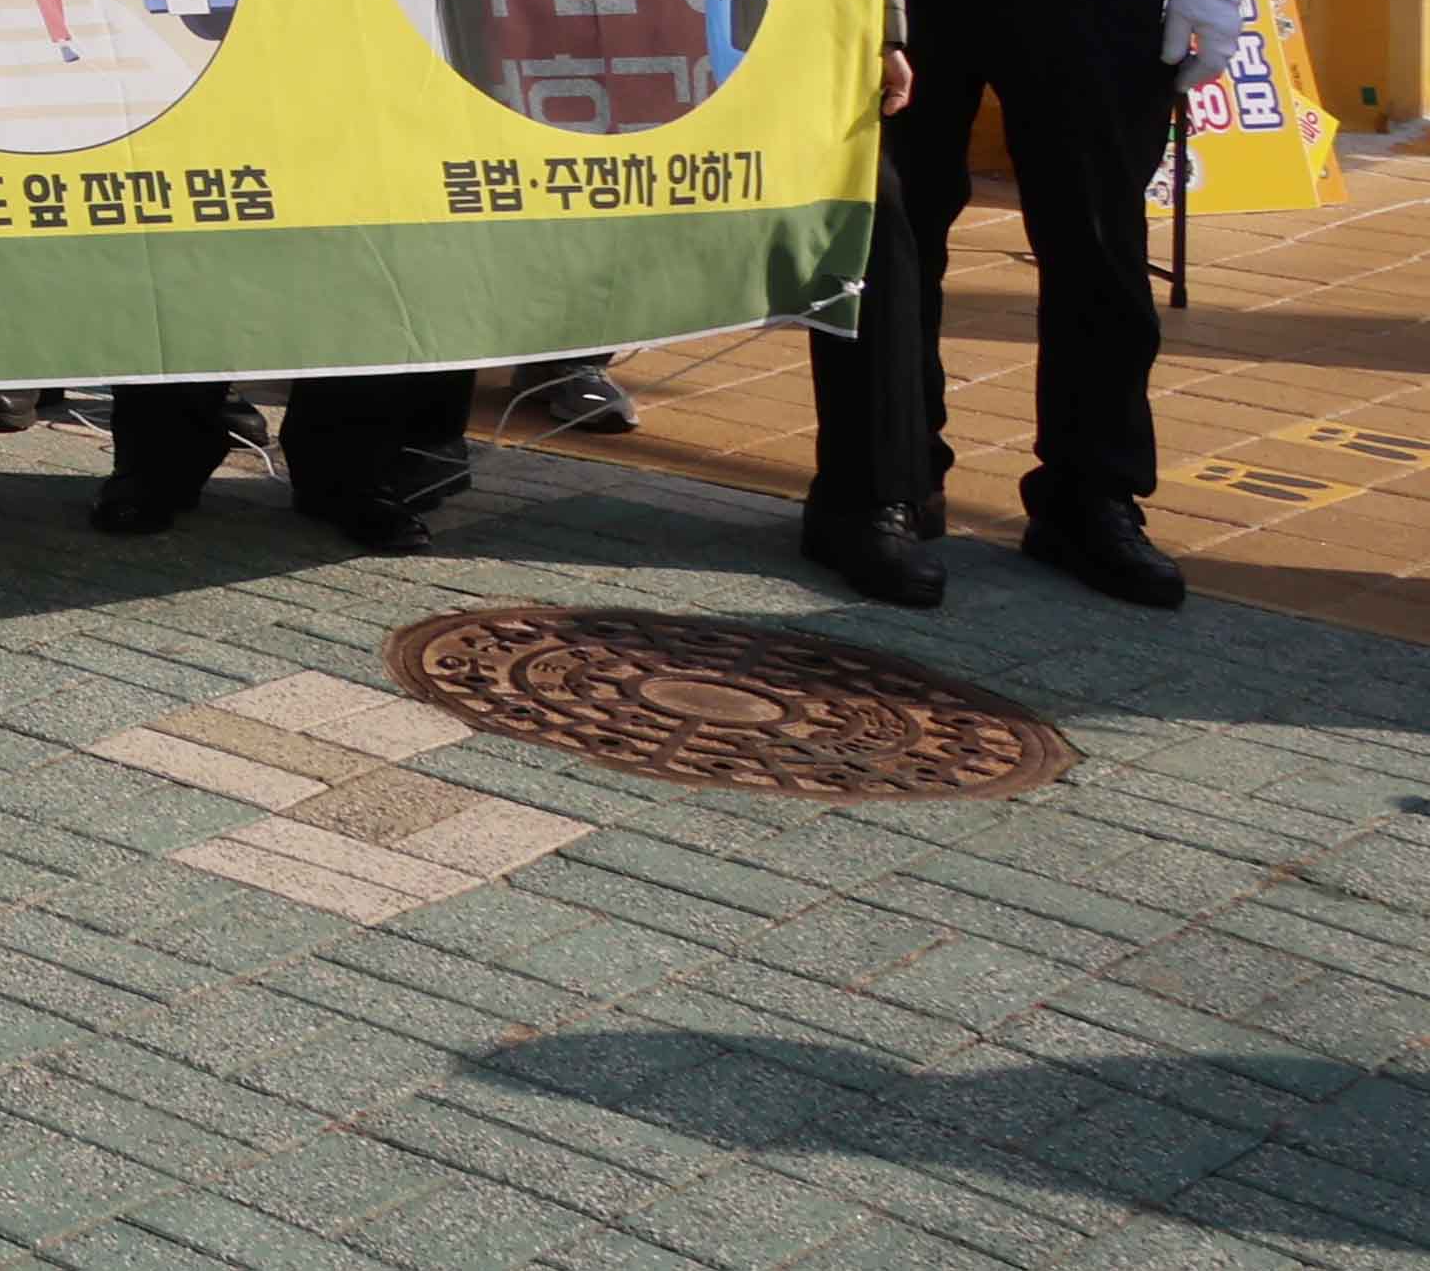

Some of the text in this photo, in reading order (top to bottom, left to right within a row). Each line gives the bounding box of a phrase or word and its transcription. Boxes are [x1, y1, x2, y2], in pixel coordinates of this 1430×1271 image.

[24, 173, 68, 230] 앞
[82, 170, 173, 227] 잠깐
[187, 167, 275, 223] 멈춤
[668, 151, 763, 206] 안하기
